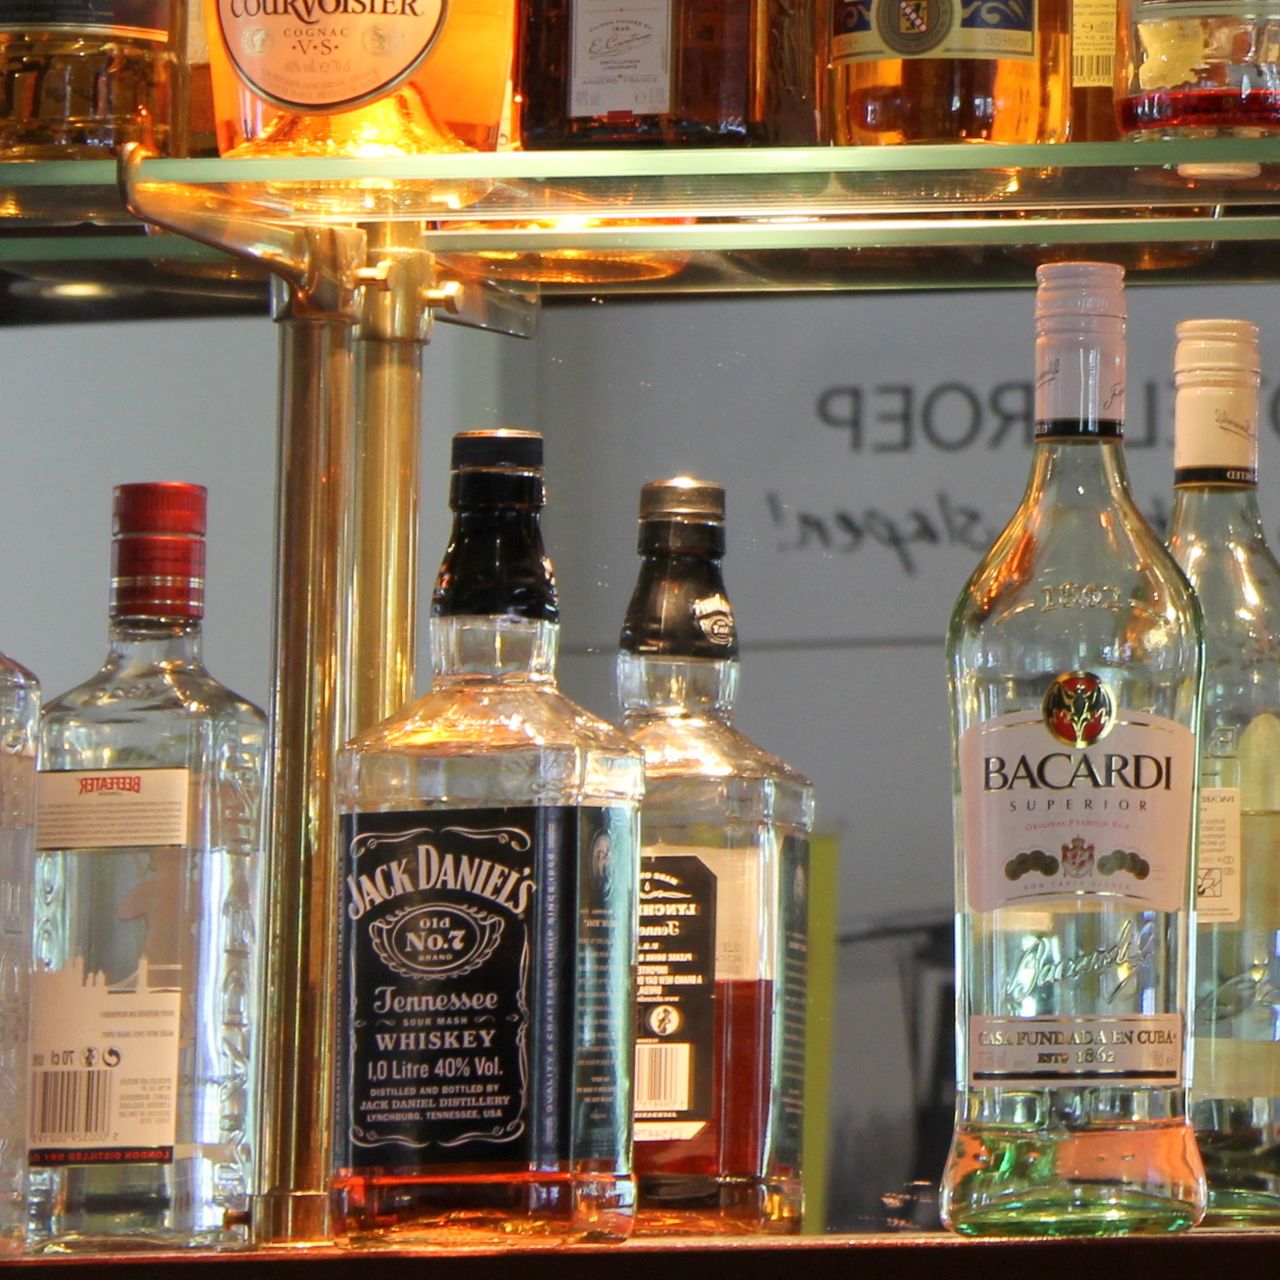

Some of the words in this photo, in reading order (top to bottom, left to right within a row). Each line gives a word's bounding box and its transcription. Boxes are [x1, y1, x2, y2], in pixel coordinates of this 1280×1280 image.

[283, 27, 350, 38] COGNAC
[982, 752, 1172, 793] BACARDI
[1008, 798, 1149, 812] SUPERIOR
[346, 856, 415, 921] JACK
[416, 843, 537, 915] DANIEL'S
[404, 930, 466, 953] No.7
[418, 952, 454, 962] BRAND
[372, 985, 499, 1015] Tennessee
[402, 1017, 433, 1027] SOUR
[436, 1015, 469, 1026] MASH
[375, 1029, 498, 1052] WHISKEY
[978, 1030, 1013, 1046] CASA
[1016, 1031, 1108, 1047] FUNDADA
[1111, 1030, 1135, 1045] EN
[1136, 1030, 1174, 1045] CUBA
[1075, 1047, 1116, 1064] 1862
[392, 1059, 430, 1079] Litre
[433, 1057, 470, 1078] 40%
[475, 1056, 504, 1076] Vol.
[370, 1086, 417, 1097] DISTILLED
[419, 1086, 439, 1096] AND
[441, 1084, 485, 1095] BOTTLED
[486, 1083, 500, 1093] BY
[360, 1099, 389, 1111] JACK
[391, 1097, 437, 1111] DANIEL
[439, 1095, 512, 1109] DISTILLERY
[483, 1108, 503, 1120] USA
